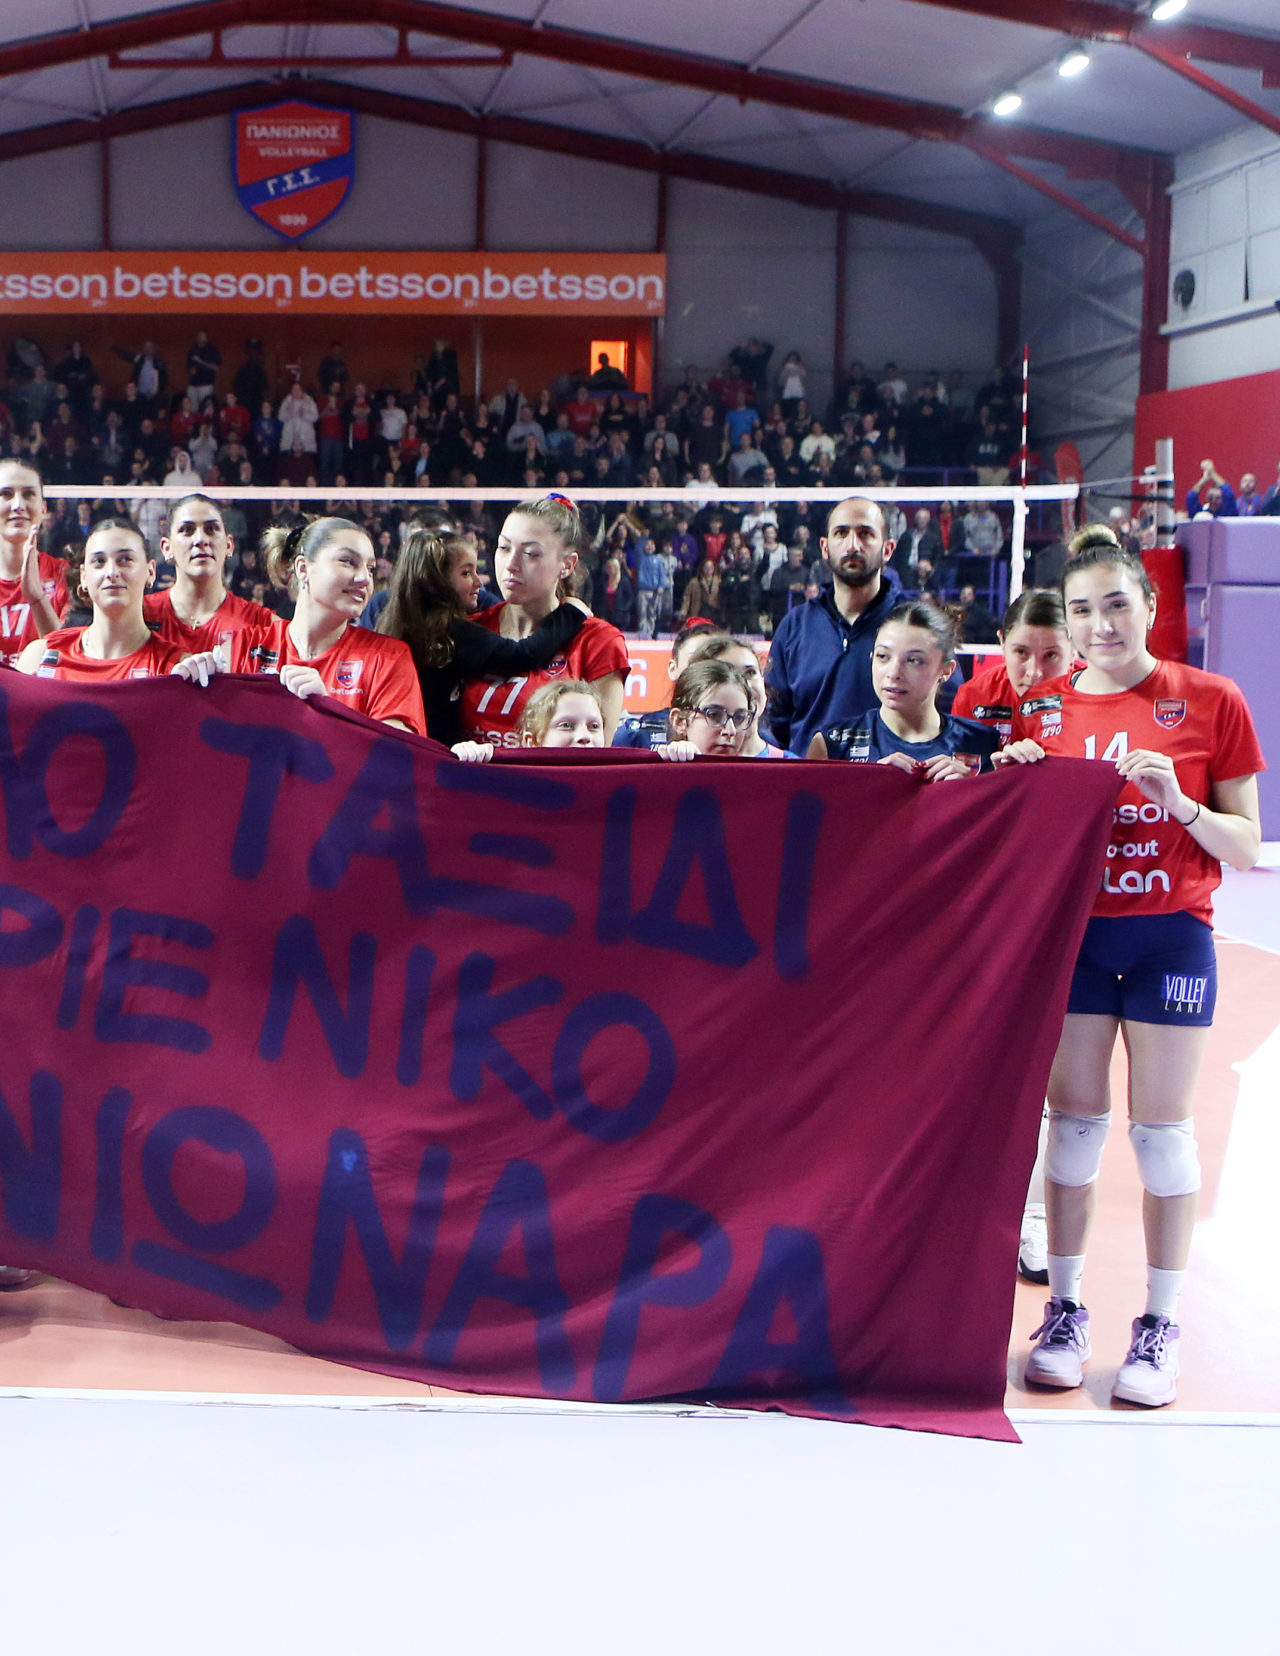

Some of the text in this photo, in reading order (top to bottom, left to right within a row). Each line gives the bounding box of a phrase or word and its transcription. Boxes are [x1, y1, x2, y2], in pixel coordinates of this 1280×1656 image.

[246, 125, 339, 139] ΠΑΝΙΩΝΙΟΣ
[259, 147, 327, 157] VOLLEYBALL
[114, 266, 293, 299] betsson
[301, 266, 478, 299] betsson
[484, 267, 663, 300] betsson
[0, 602, 30, 638] 17
[476, 674, 529, 715] 77
[1040, 725, 1063, 739] 1890
[1084, 731, 1128, 760] 14
[200, 718, 824, 980] ΤΑΞΙΔΙ
[1164, 974, 1208, 1003] VOLLEY
[1164, 1002, 1203, 1014] LAND
[259, 916, 677, 1143] ΝΙΚΟ
